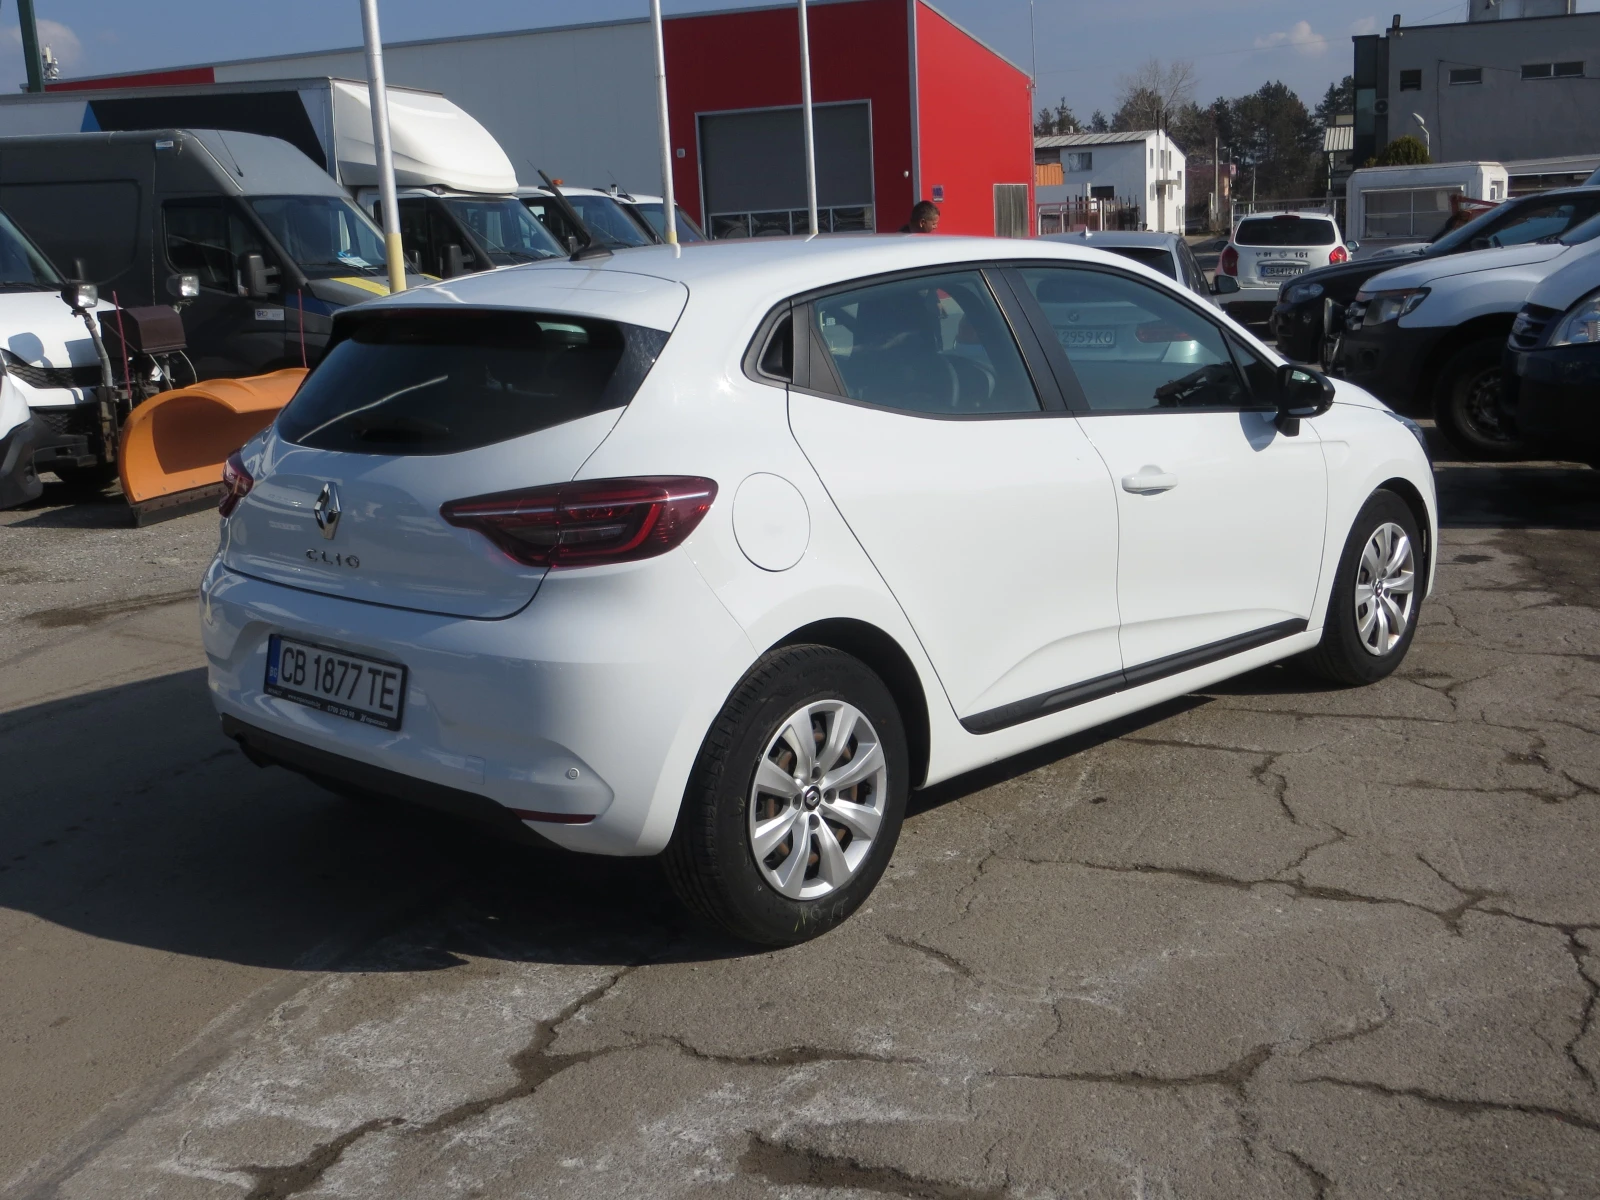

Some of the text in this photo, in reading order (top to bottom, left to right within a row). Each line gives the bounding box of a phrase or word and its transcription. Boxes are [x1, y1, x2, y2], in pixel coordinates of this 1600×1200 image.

[306, 548, 360, 568] CLIO
[281, 646, 396, 711] CB 1877 TE
